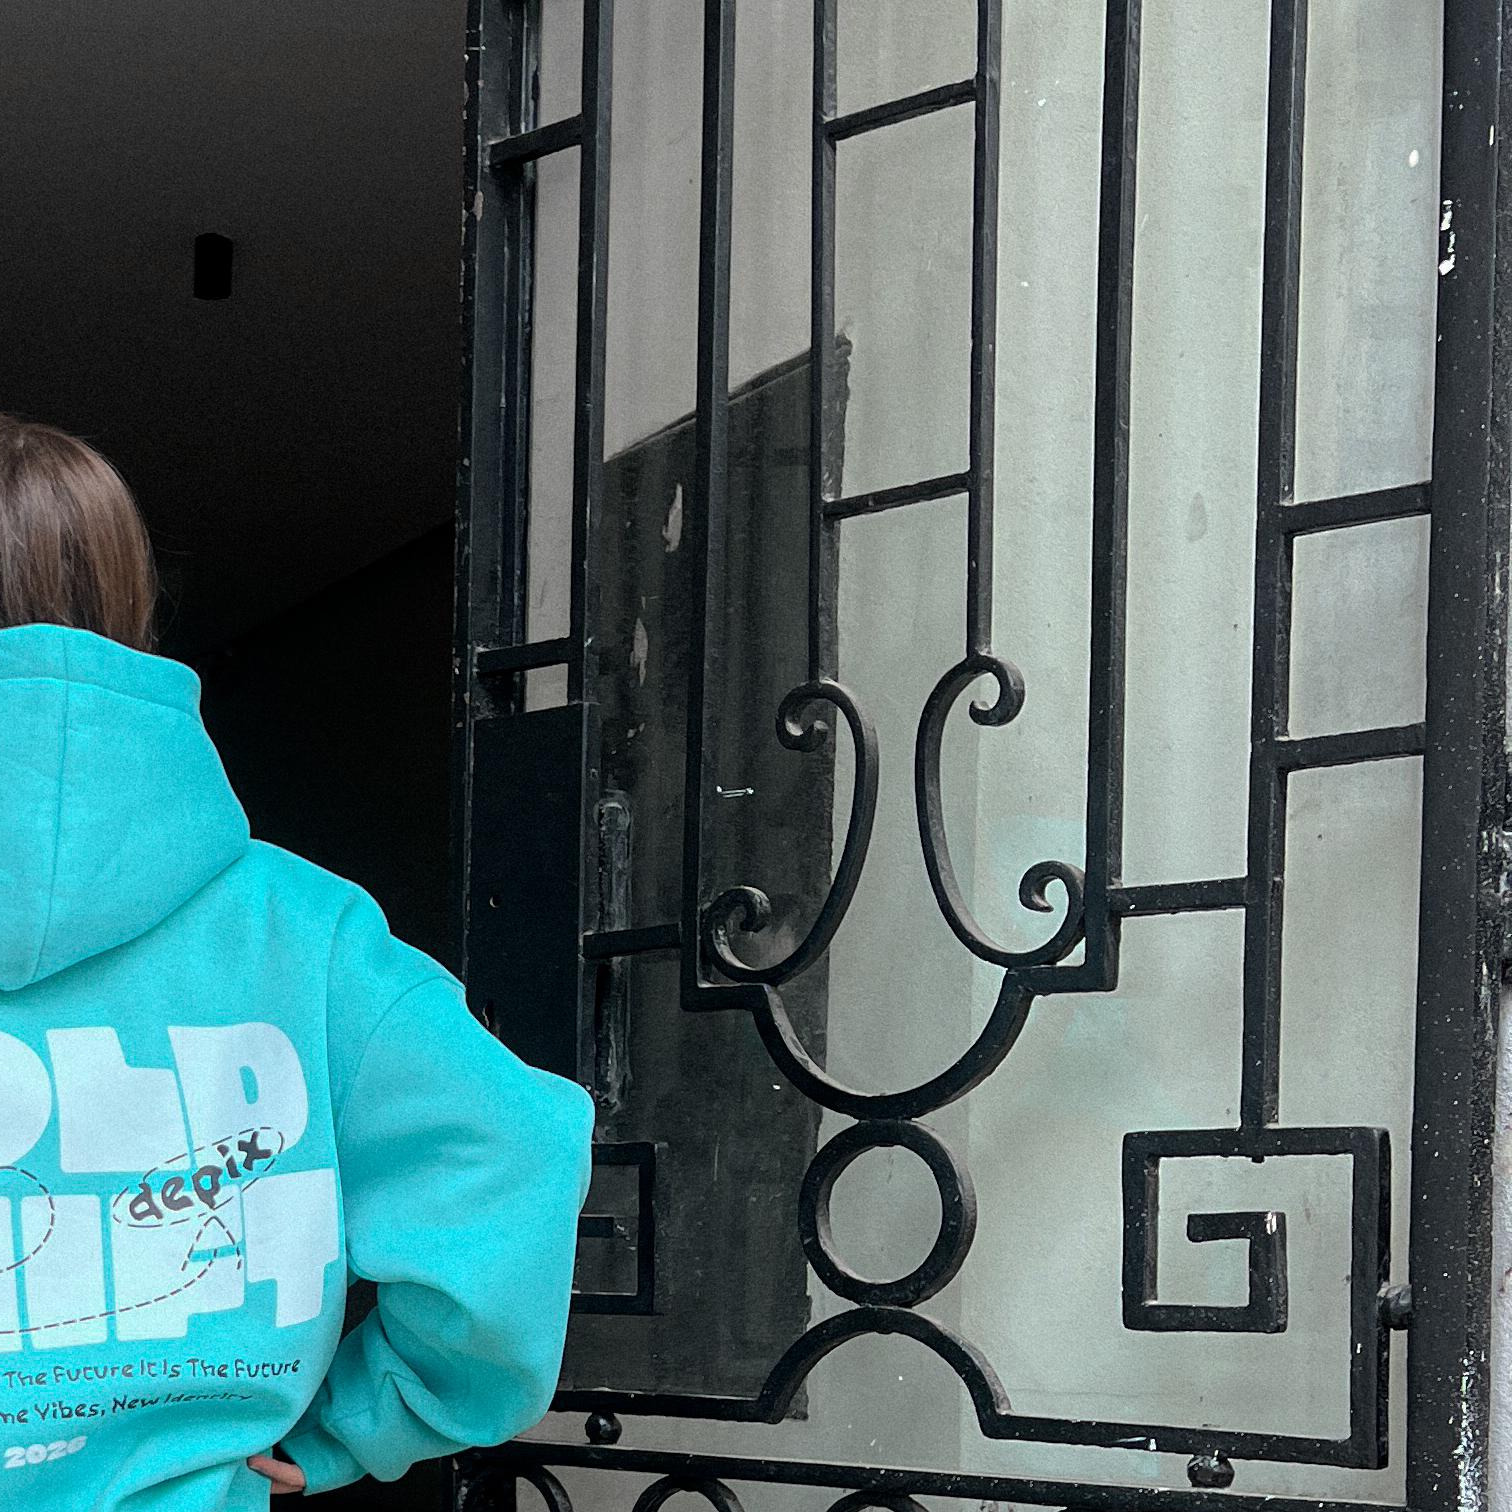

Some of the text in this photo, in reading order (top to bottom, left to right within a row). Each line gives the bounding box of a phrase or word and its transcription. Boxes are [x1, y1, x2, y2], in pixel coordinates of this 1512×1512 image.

[129, 1131, 273, 1221] depix
[3, 1370, 47, 1389] The
[53, 1364, 133, 1383] Future
[140, 1358, 158, 1378] It
[162, 1359, 182, 1378] Is
[186, 1358, 228, 1378] The
[235, 1359, 301, 1378] Future
[34, 1401, 106, 1421] Vibes,
[111, 1395, 160, 1414] New
